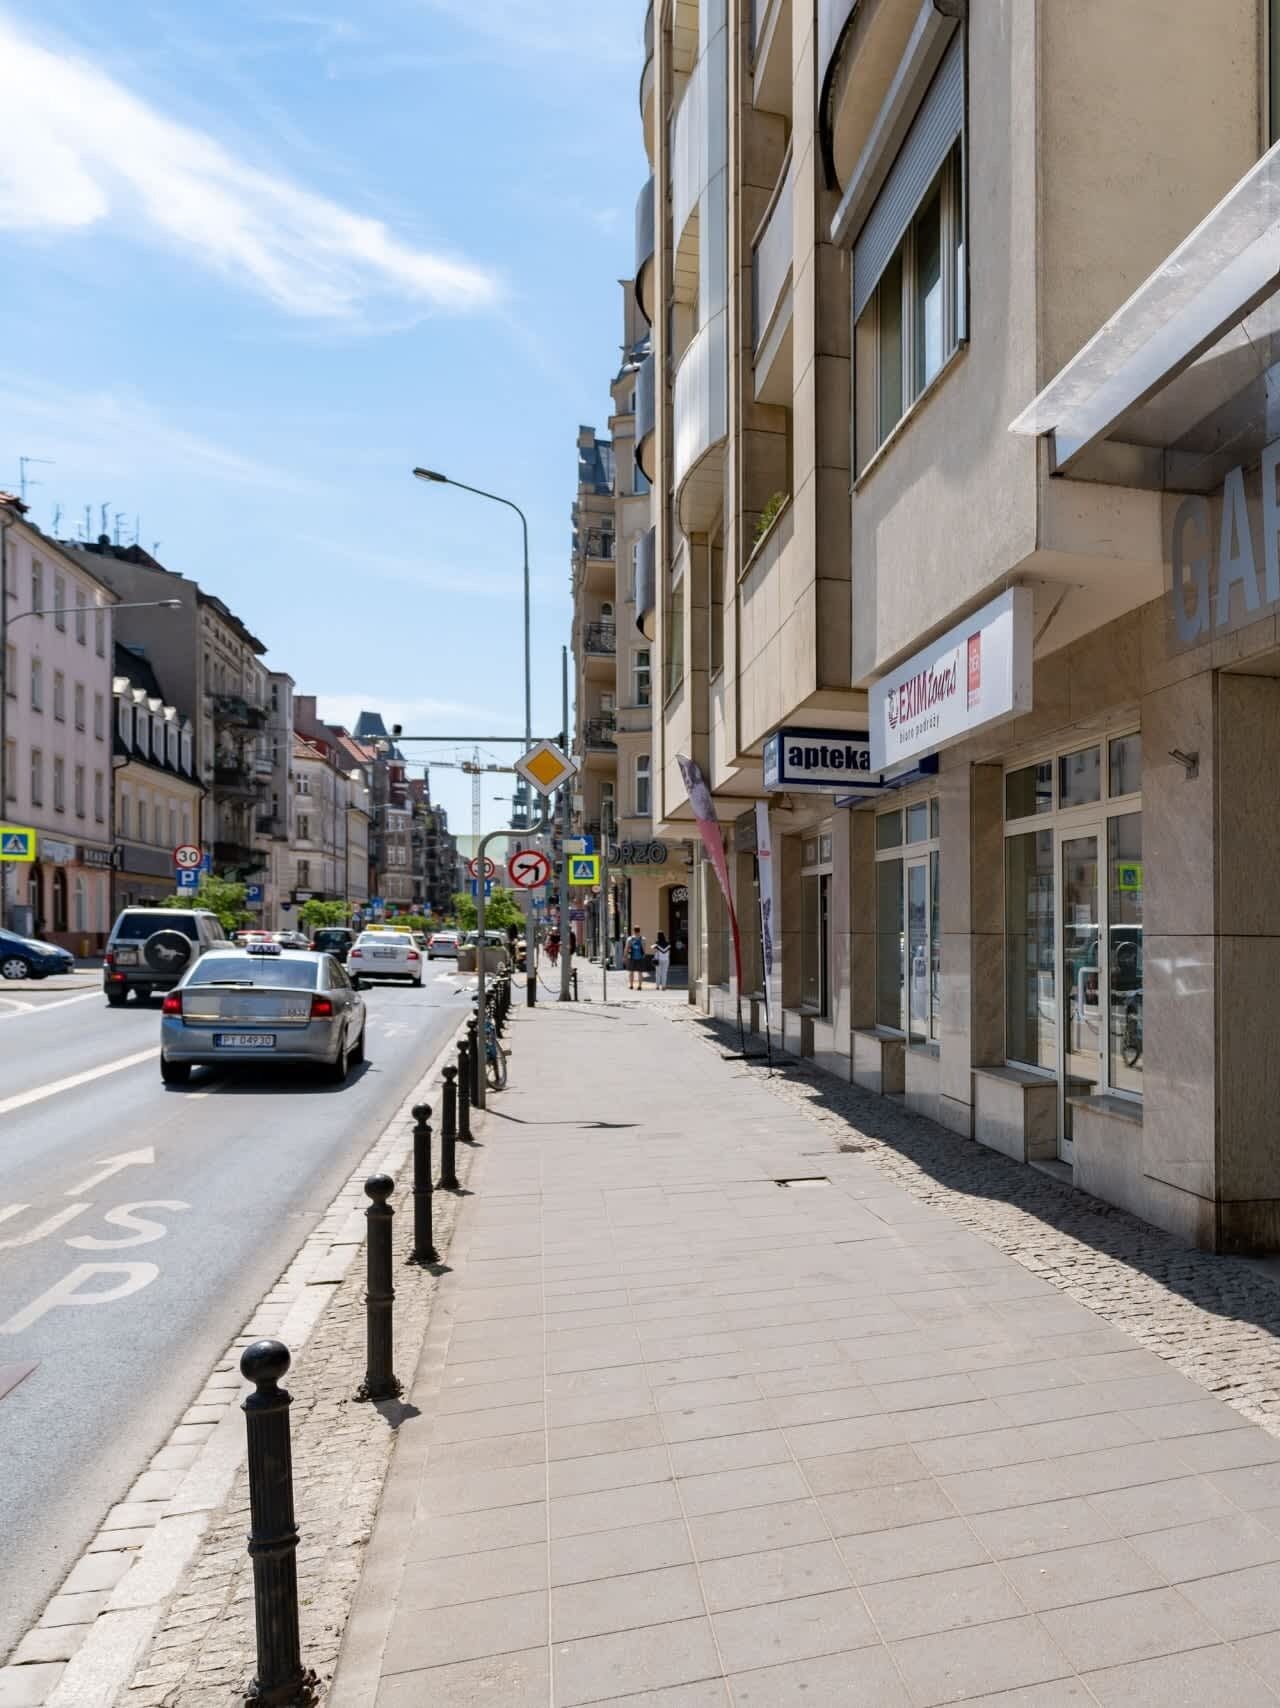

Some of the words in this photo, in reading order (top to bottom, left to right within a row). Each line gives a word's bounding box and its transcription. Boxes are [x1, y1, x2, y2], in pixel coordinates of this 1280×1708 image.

[788, 744, 870, 771] apteka
[178, 850, 197, 864] 30
[181, 870, 195, 885] P
[251, 944, 277, 952] TAXI
